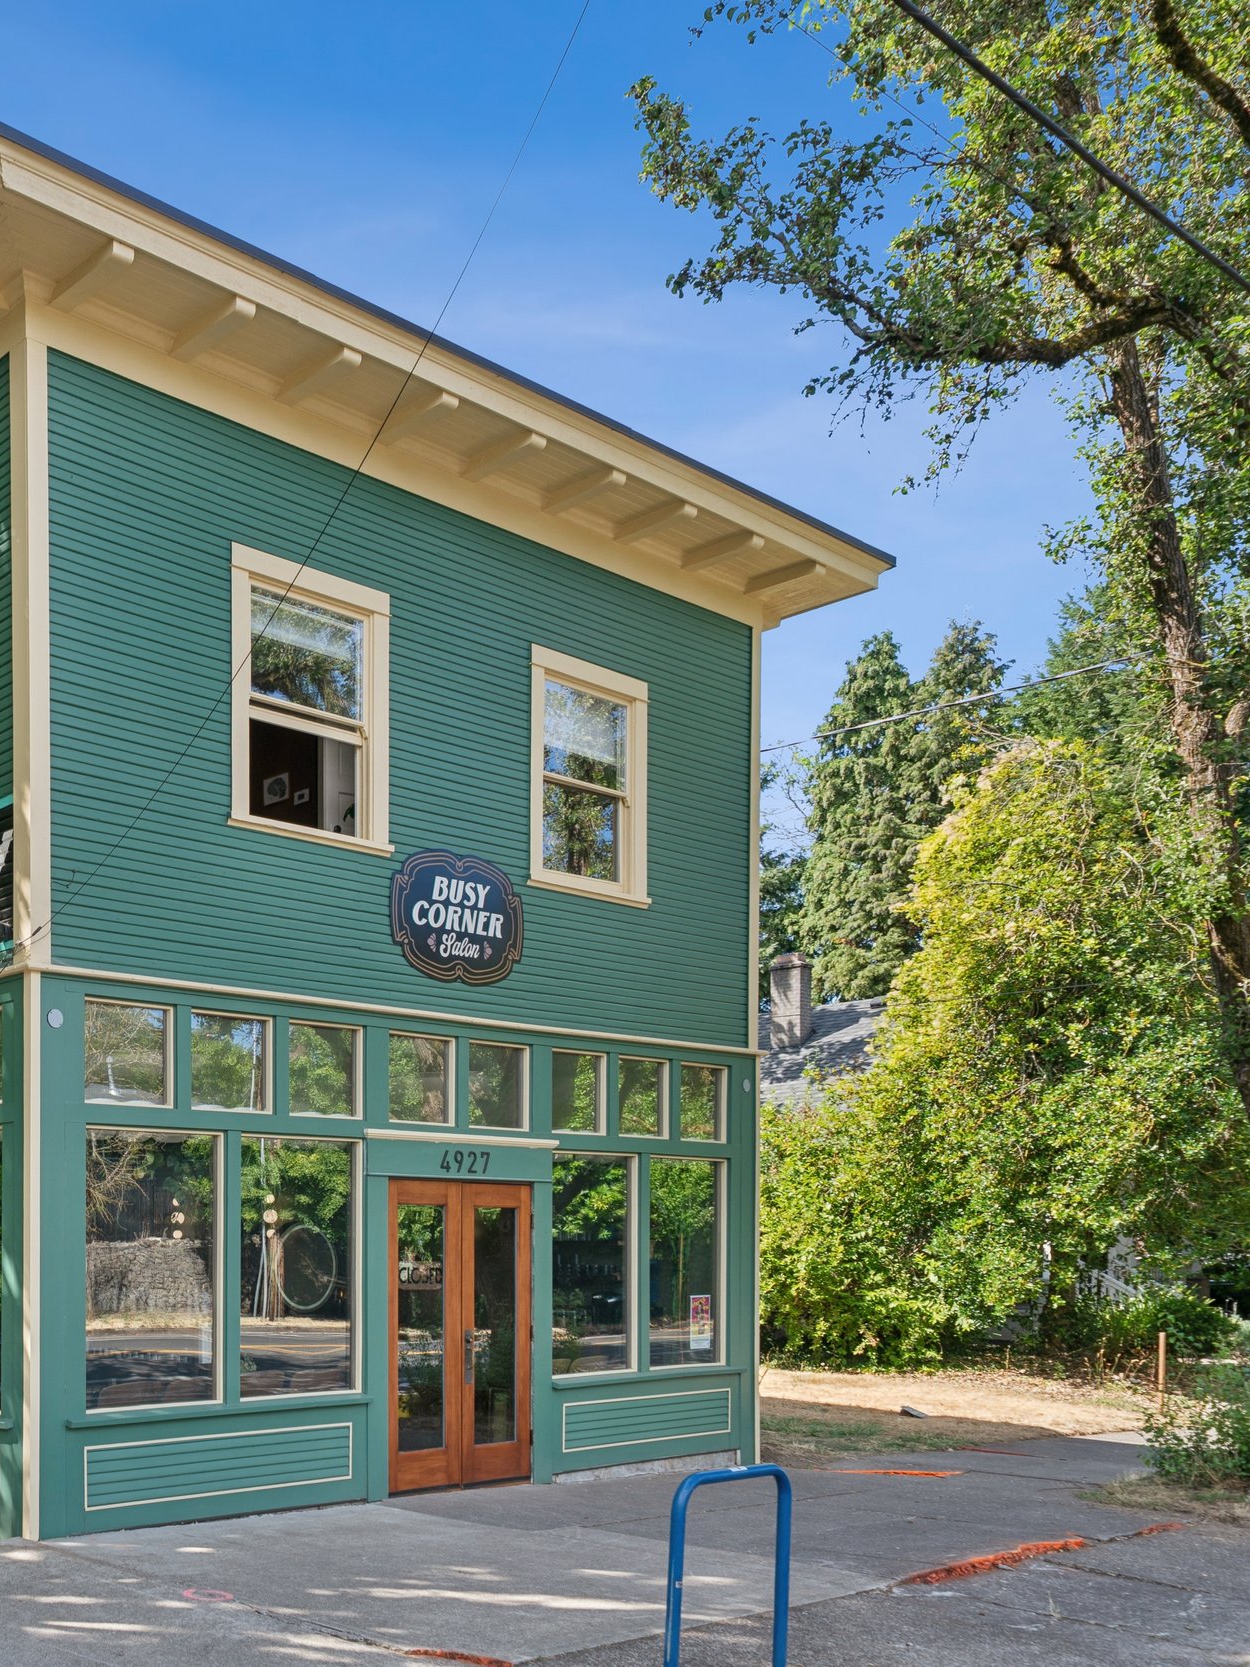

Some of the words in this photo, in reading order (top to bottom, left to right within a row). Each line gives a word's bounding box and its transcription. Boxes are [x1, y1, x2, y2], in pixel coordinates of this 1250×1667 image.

[432, 876, 490, 908] BUSY
[412, 900, 504, 938] CORNER
[440, 932, 480, 959] Salon
[440, 1150, 491, 1174] 4927
